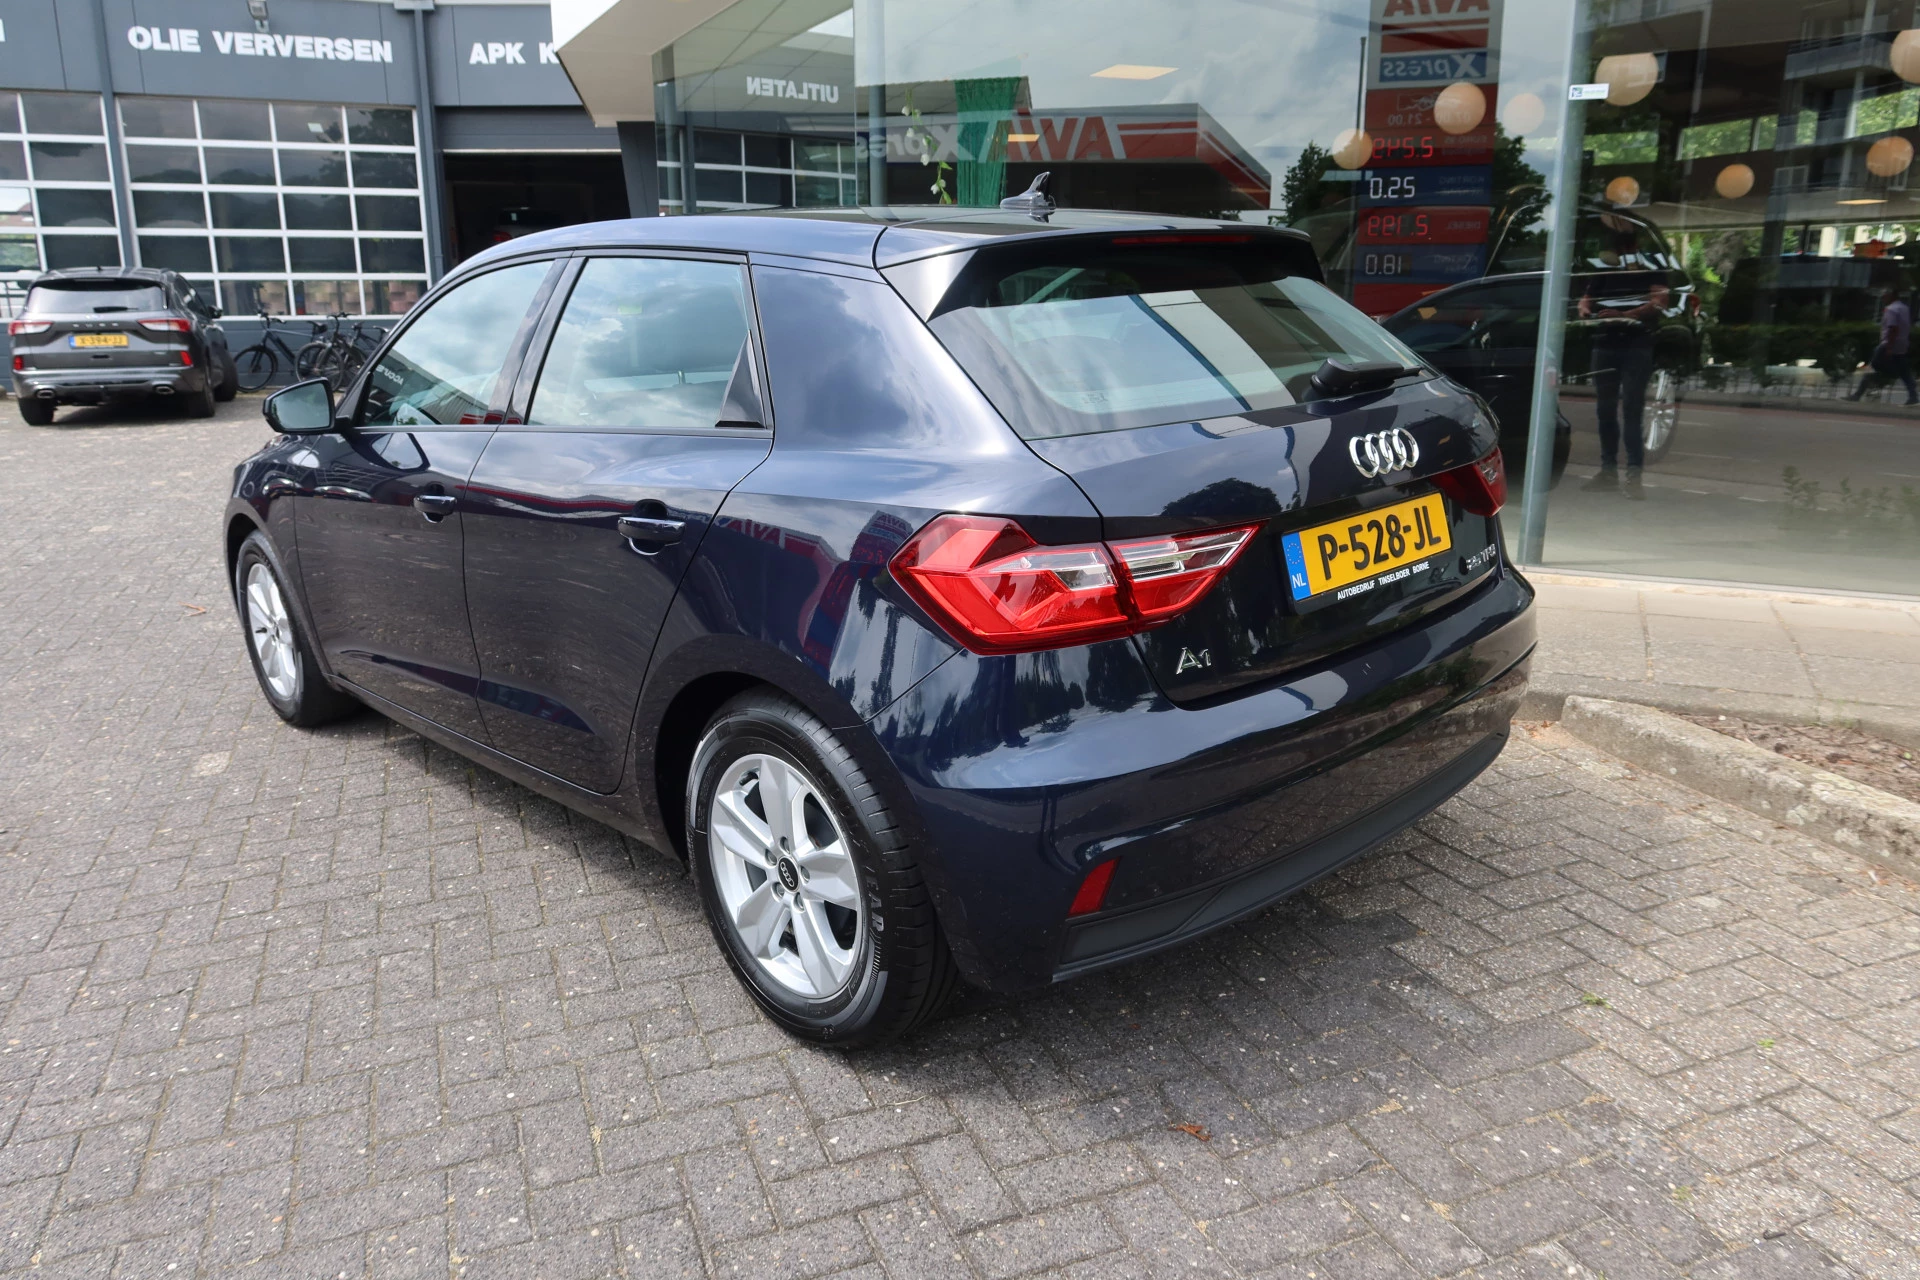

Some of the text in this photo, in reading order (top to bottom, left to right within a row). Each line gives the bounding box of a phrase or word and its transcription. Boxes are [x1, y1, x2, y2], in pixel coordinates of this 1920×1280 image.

[127, 25, 394, 63] OLIE VERVERSEN
[468, 41, 527, 65] APK
[1317, 505, 1442, 581] P-528-JL
[1292, 572, 1307, 589] NL
[1337, 580, 1376, 600] AUTOBEDRIJF
[1412, 561, 1430, 574] BORNE
[1176, 646, 1212, 675] A1
